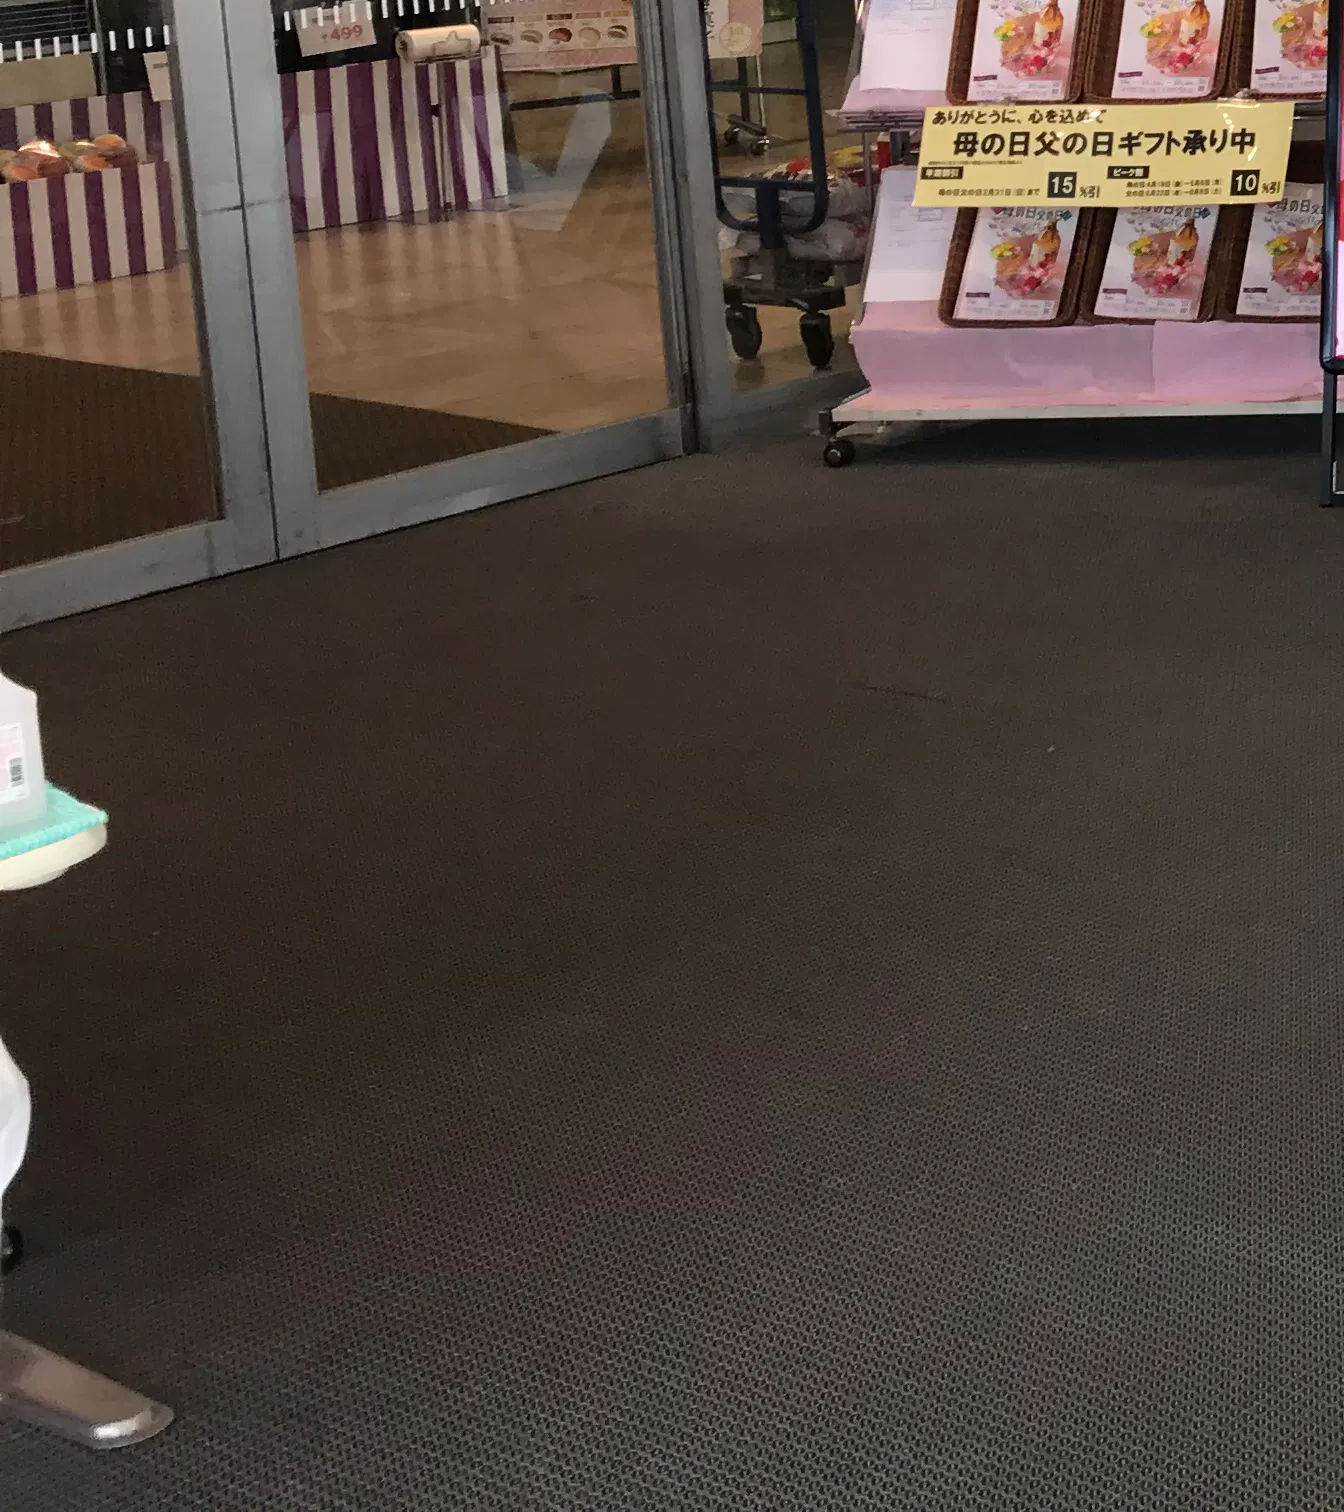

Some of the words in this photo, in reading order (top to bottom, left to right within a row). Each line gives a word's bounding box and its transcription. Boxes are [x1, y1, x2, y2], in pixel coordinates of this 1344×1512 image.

[330, 24, 363, 41] 499
[953, 129, 1256, 158] 母の日父の日ギフト承り中
[1051, 177, 1074, 194] 15
[1235, 174, 1257, 192] 10
